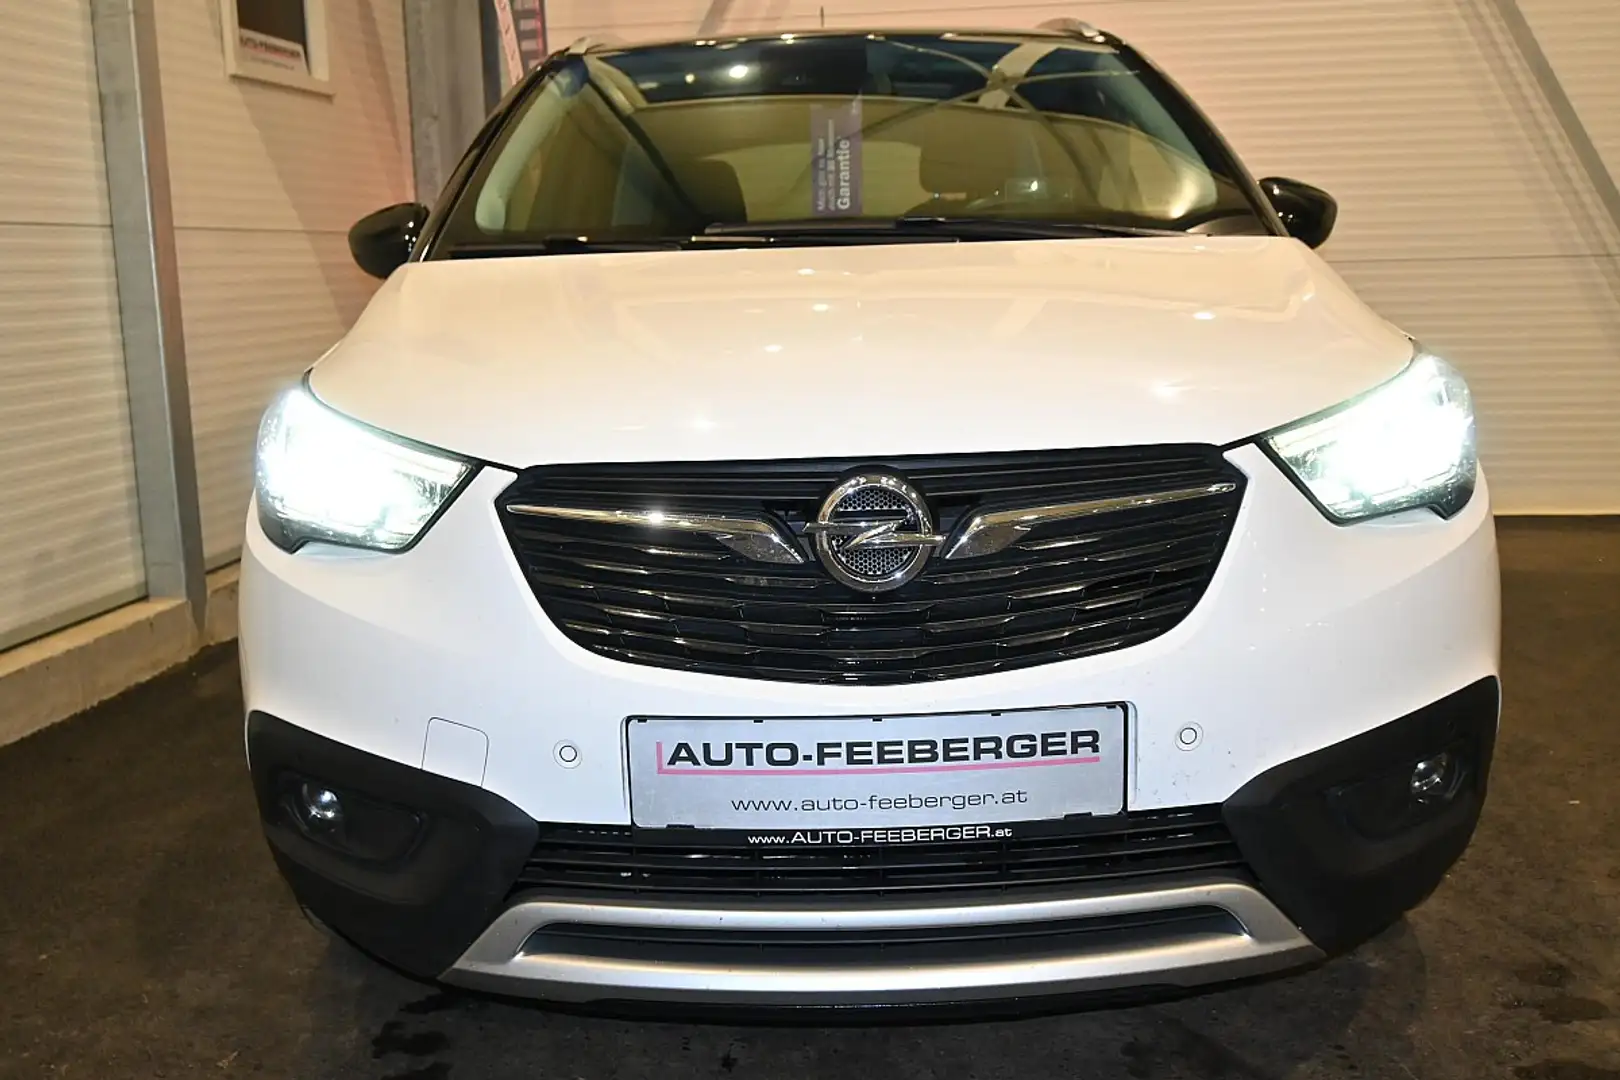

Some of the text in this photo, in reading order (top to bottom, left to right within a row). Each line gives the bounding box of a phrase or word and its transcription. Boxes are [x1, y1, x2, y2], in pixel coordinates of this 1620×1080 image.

[667, 730, 1100, 766] AUTO-FEEBERGER
[731, 788, 1028, 811] www.auto-feeberger.at
[748, 826, 1013, 845] www.AUTO-FEEBERGER.at
